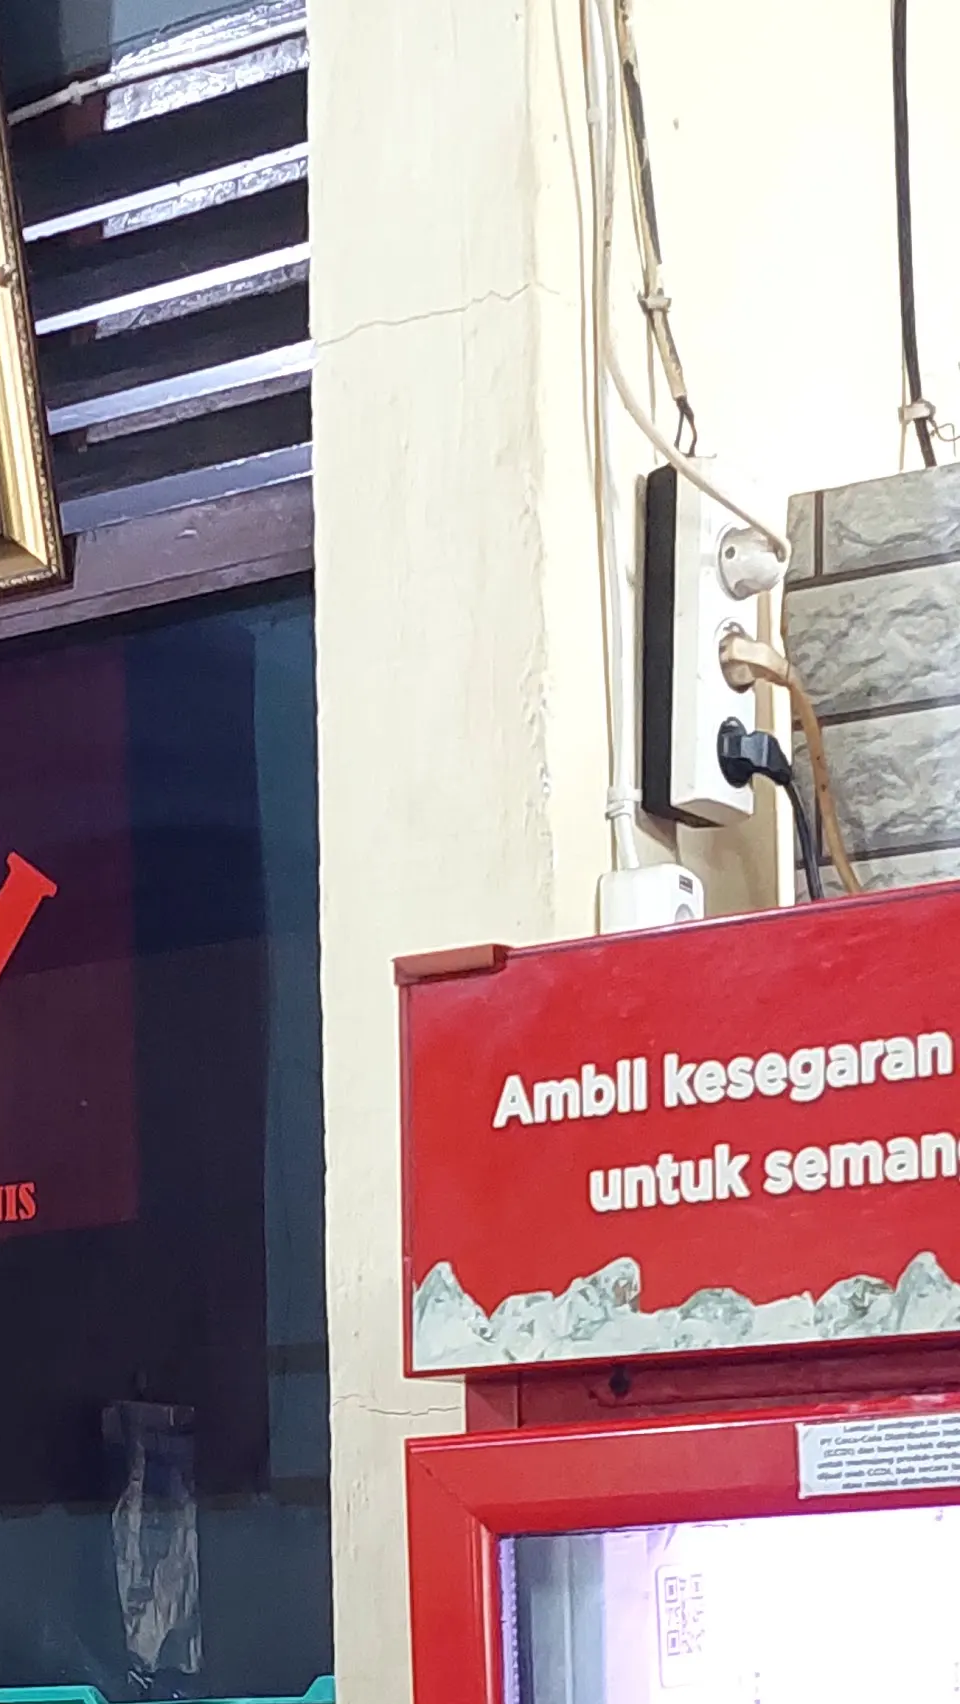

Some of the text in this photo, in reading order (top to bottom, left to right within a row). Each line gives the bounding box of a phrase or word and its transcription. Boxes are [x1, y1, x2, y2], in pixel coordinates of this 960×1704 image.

[664, 1031, 952, 1106] kesegaran
[589, 1131, 960, 1212] untuk seman
